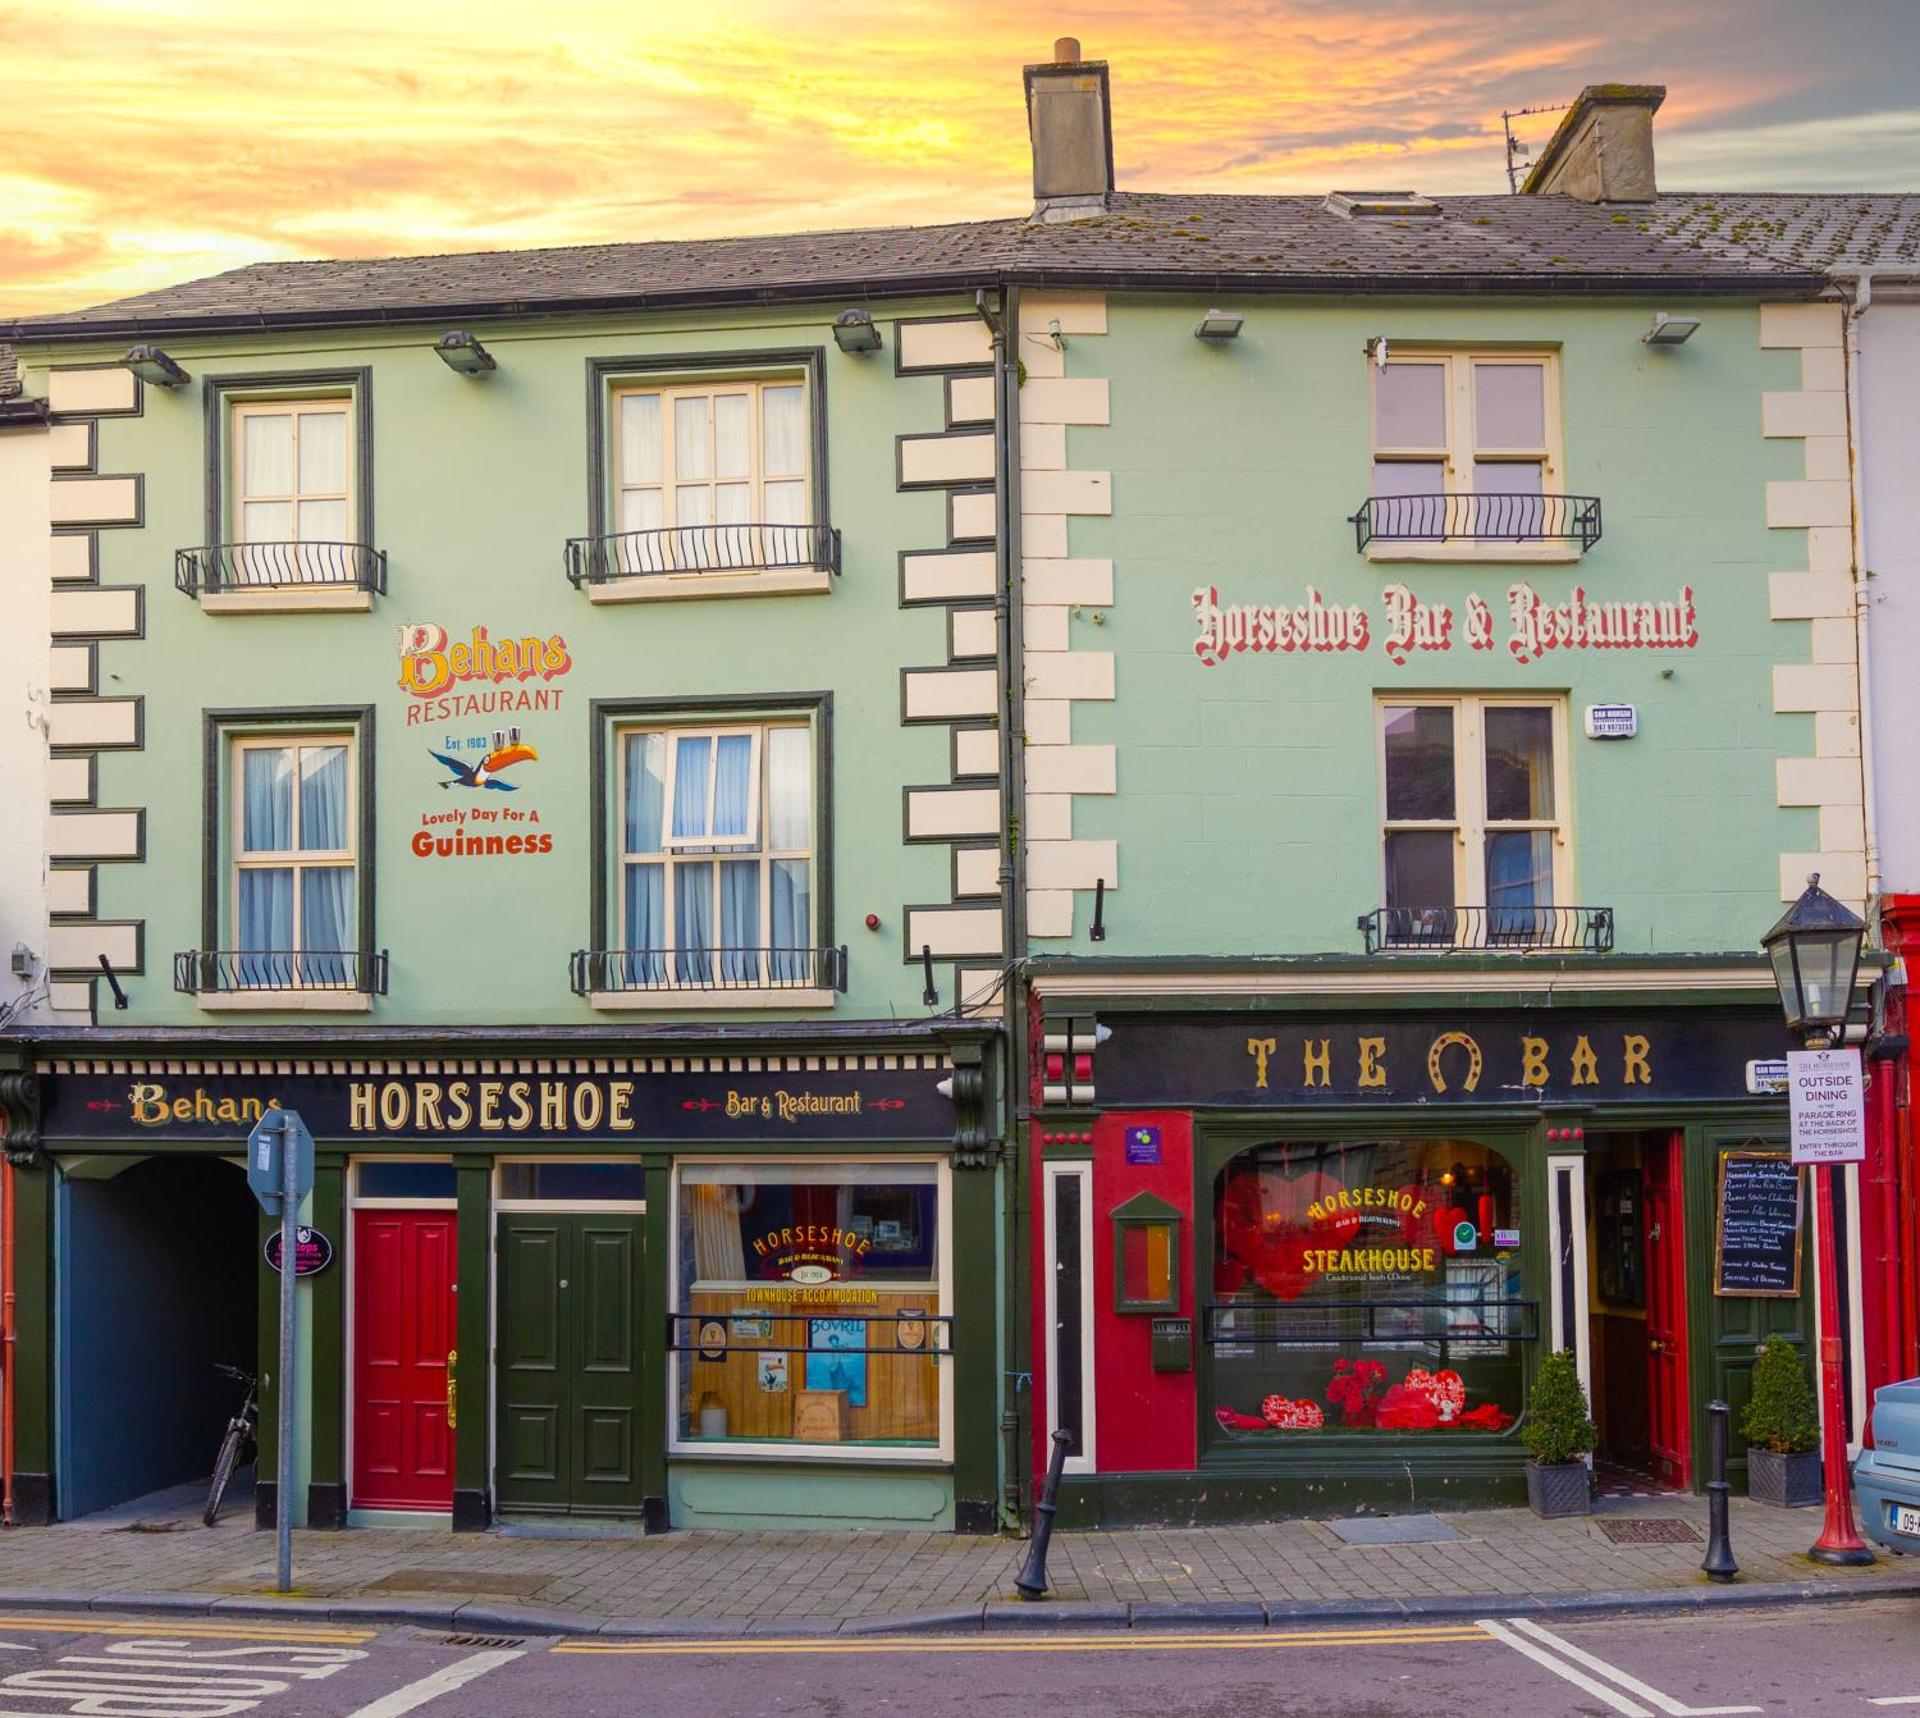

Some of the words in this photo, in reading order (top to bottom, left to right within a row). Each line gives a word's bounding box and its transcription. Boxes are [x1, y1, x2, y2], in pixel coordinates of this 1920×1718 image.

[1191, 585, 1370, 666] Horseshoe
[1382, 581, 1453, 665] Bar
[1463, 591, 1495, 651] &
[1507, 581, 1699, 664] Restaurant
[396, 621, 573, 699] Behans
[406, 689, 564, 726] RESTAURANT
[422, 809, 467, 826] Lovely
[471, 808, 498, 822] Day
[503, 808, 525, 822] For
[530, 810, 540, 823] A
[412, 829, 553, 859] Guinness
[1247, 1037, 1387, 1089] THE
[1522, 1035, 1653, 1087] BAR
[1798, 1076, 1853, 1088] OUTSIDE
[1805, 1090, 1848, 1101] DINING
[349, 1082, 635, 1130] HORSESHOE
[725, 1090, 757, 1119] Bar
[761, 1096, 773, 1118] &
[775, 1090, 862, 1122] Restaurant
[1798, 1111, 1834, 1119] PARADE
[1836, 1109, 1857, 1118] RING
[1813, 1127, 1858, 1135] HORSESHOE
[1799, 1143, 1822, 1151] ENTRY
[1824, 1141, 1858, 1149] THROUGH
[1309, 1188, 1427, 1220] HORSESHOE
[752, 1225, 872, 1256] HORSESHOE
[1302, 1248, 1437, 1273] STEAKHOUSE
[746, 1287, 798, 1303] TOWNHOUSE
[802, 1288, 879, 1304] ACCOMMODATION
[811, 1319, 865, 1335] BOVRIL
